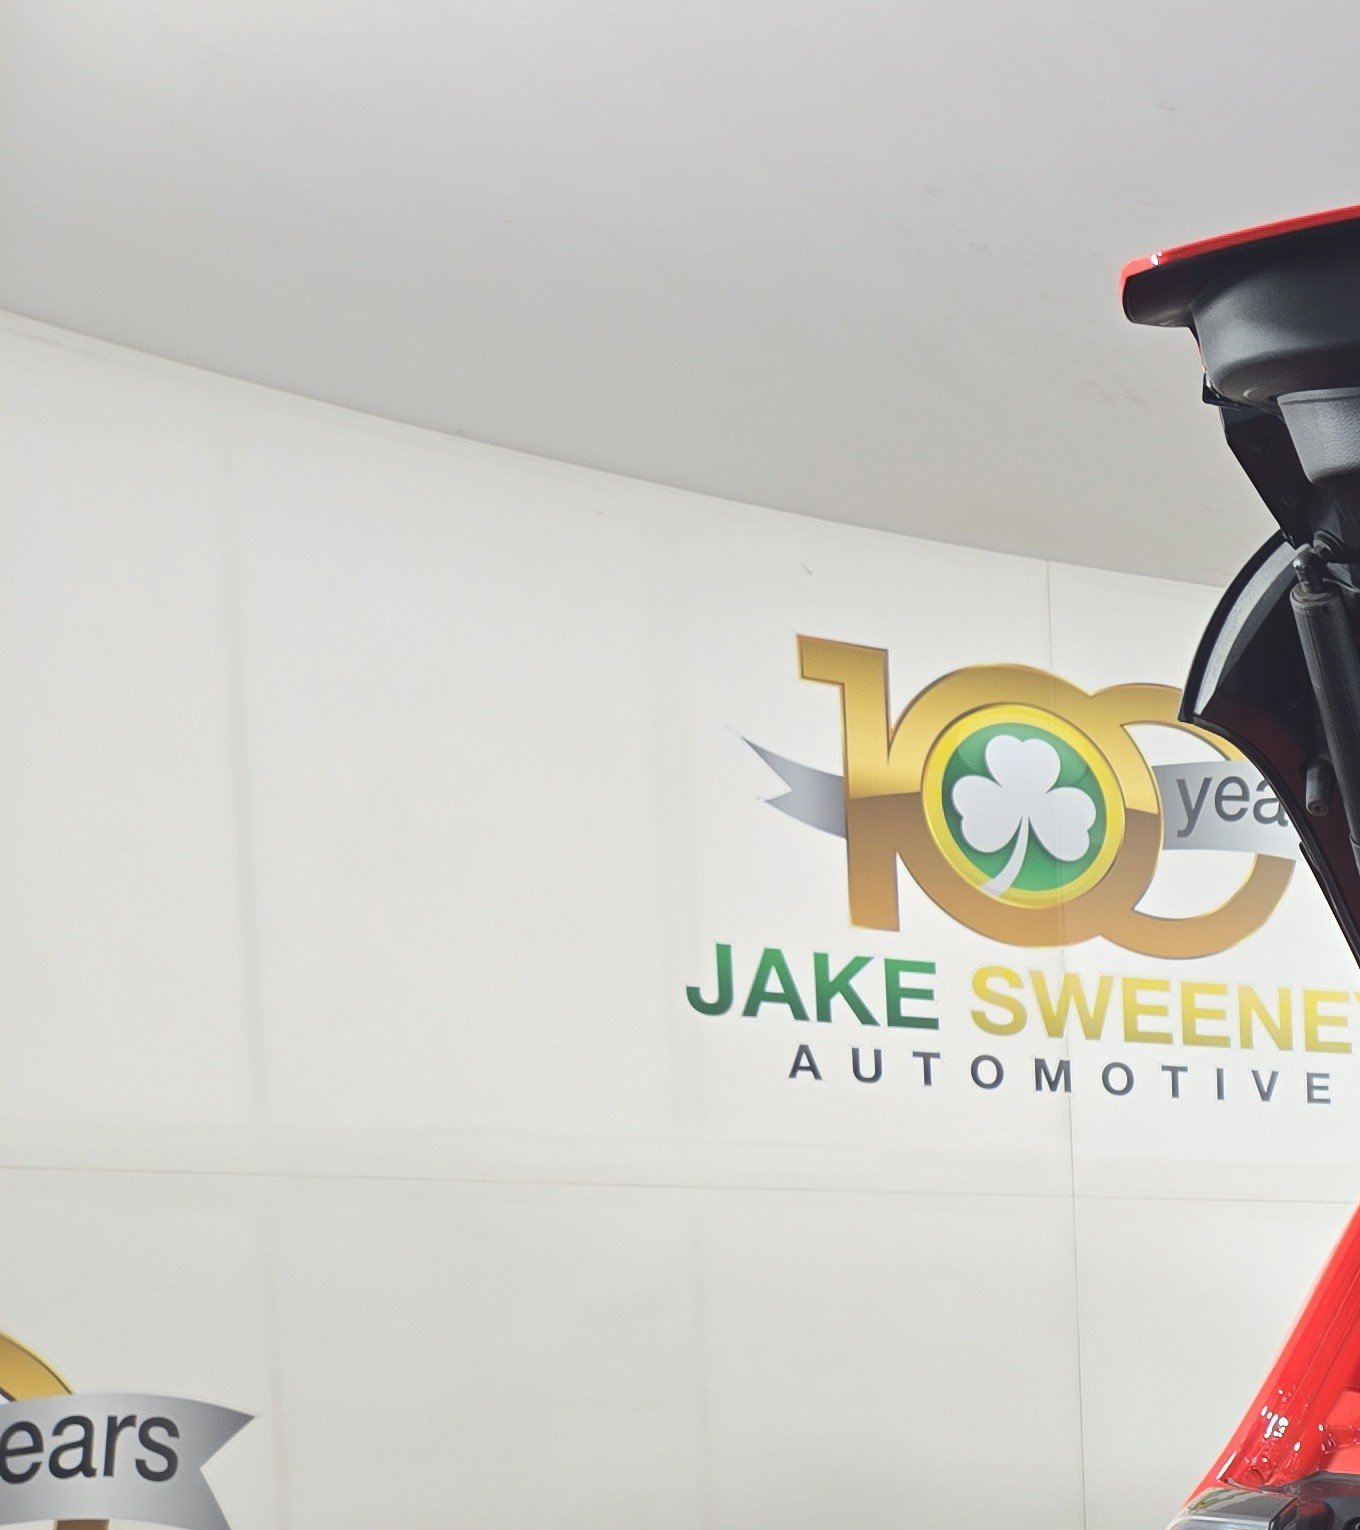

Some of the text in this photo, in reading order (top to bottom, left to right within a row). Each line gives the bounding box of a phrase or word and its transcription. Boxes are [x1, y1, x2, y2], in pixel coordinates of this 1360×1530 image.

[796, 634, 1297, 960] 100
[1175, 773, 1290, 838] yea
[685, 942, 940, 1031] JAKE
[788, 1044, 1332, 1105] AUTOMOTIVE
[0, 1413, 180, 1484] ears
